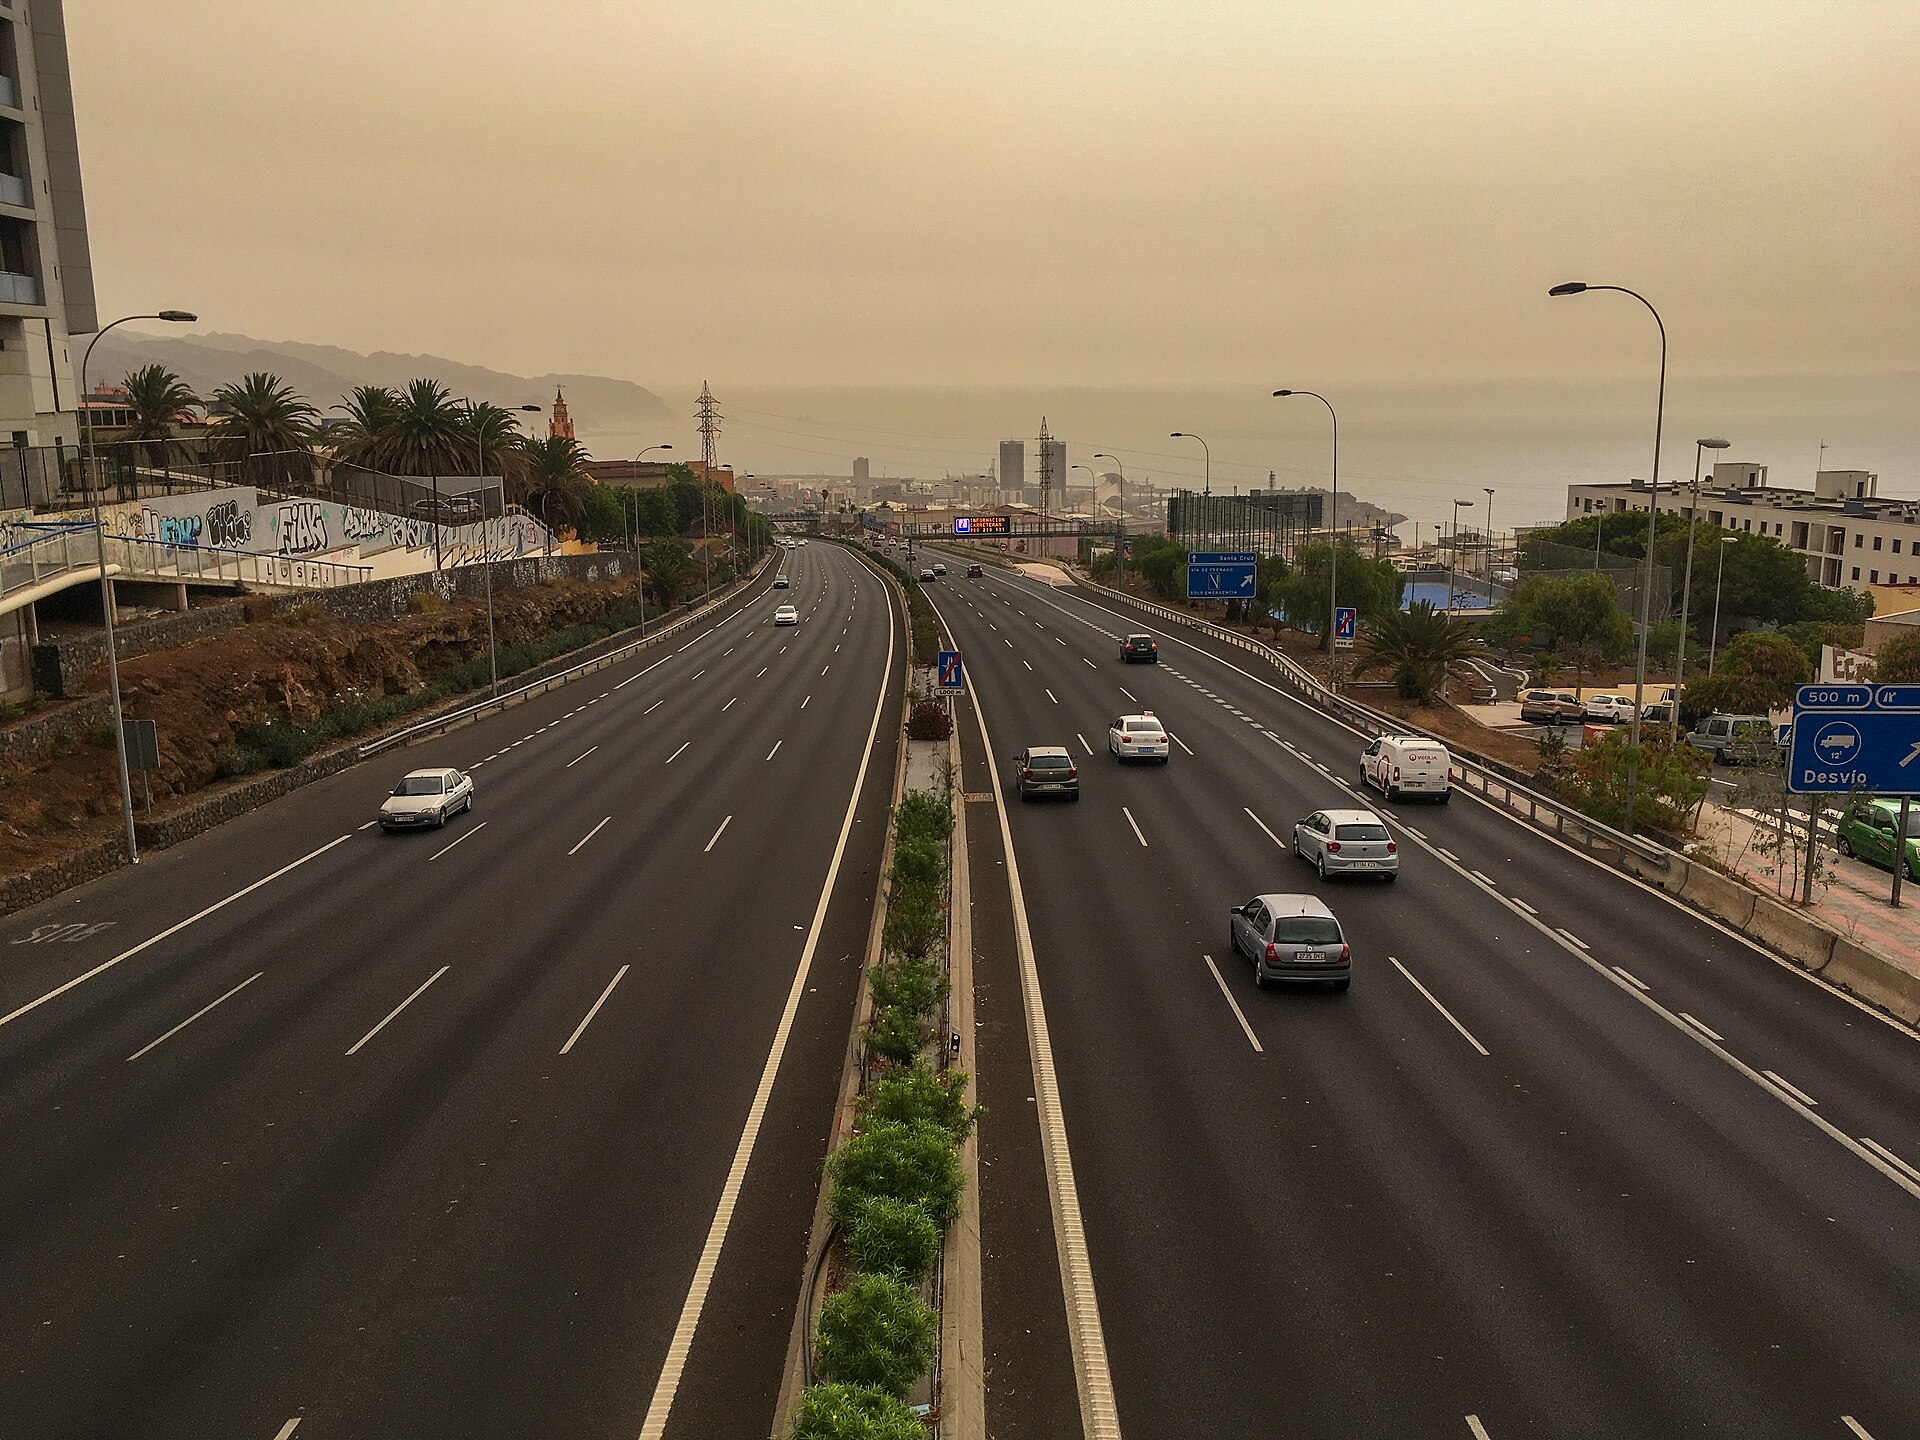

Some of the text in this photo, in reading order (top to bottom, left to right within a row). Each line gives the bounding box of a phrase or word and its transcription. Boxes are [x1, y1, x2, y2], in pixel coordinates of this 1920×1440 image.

[1808, 692, 1860, 703] 500 m
[1803, 769, 1867, 784] Desvío
